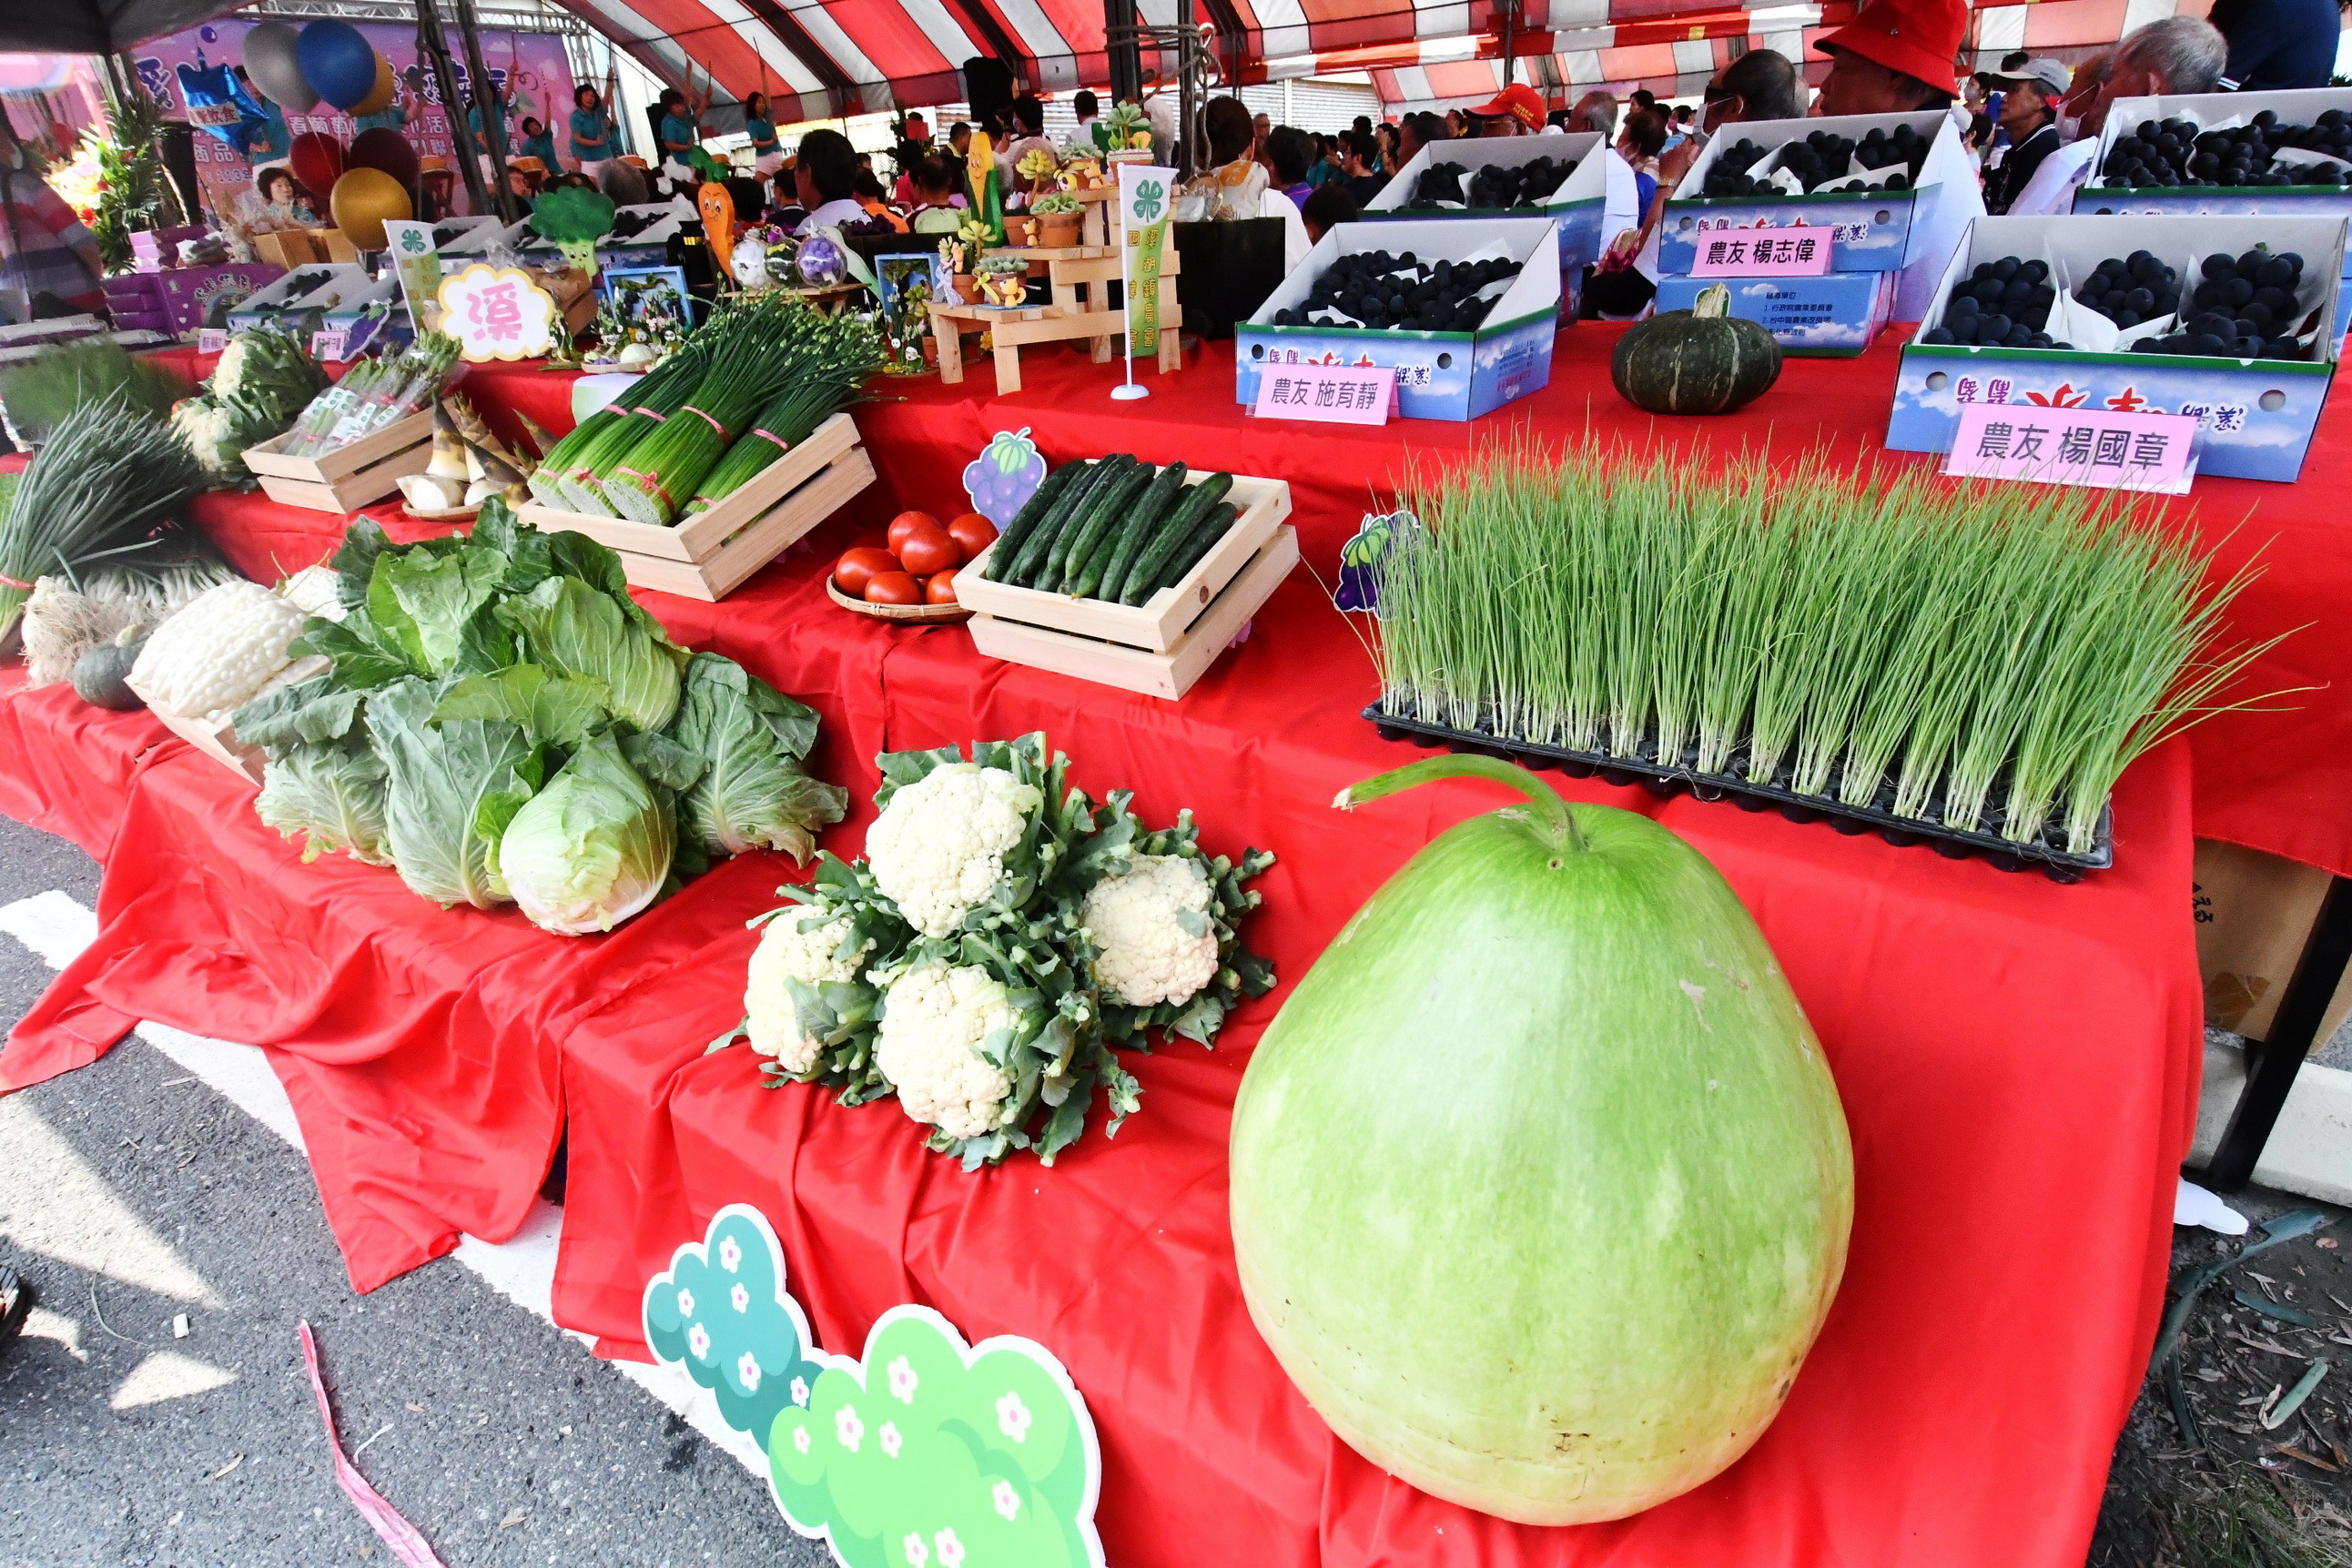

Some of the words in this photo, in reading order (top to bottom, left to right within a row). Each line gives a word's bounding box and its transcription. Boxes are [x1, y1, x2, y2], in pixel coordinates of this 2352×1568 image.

[1706, 239, 1748, 265] 農友
[1753, 238, 1816, 264] 楊志偉
[466, 282, 522, 342] 溪
[1271, 378, 1312, 406] 農友
[1314, 379, 1378, 410] 施育靜
[1957, 378, 2011, 404] 葡萄
[1976, 421, 2050, 461] 農友
[2058, 425, 2169, 470] 楊國章
